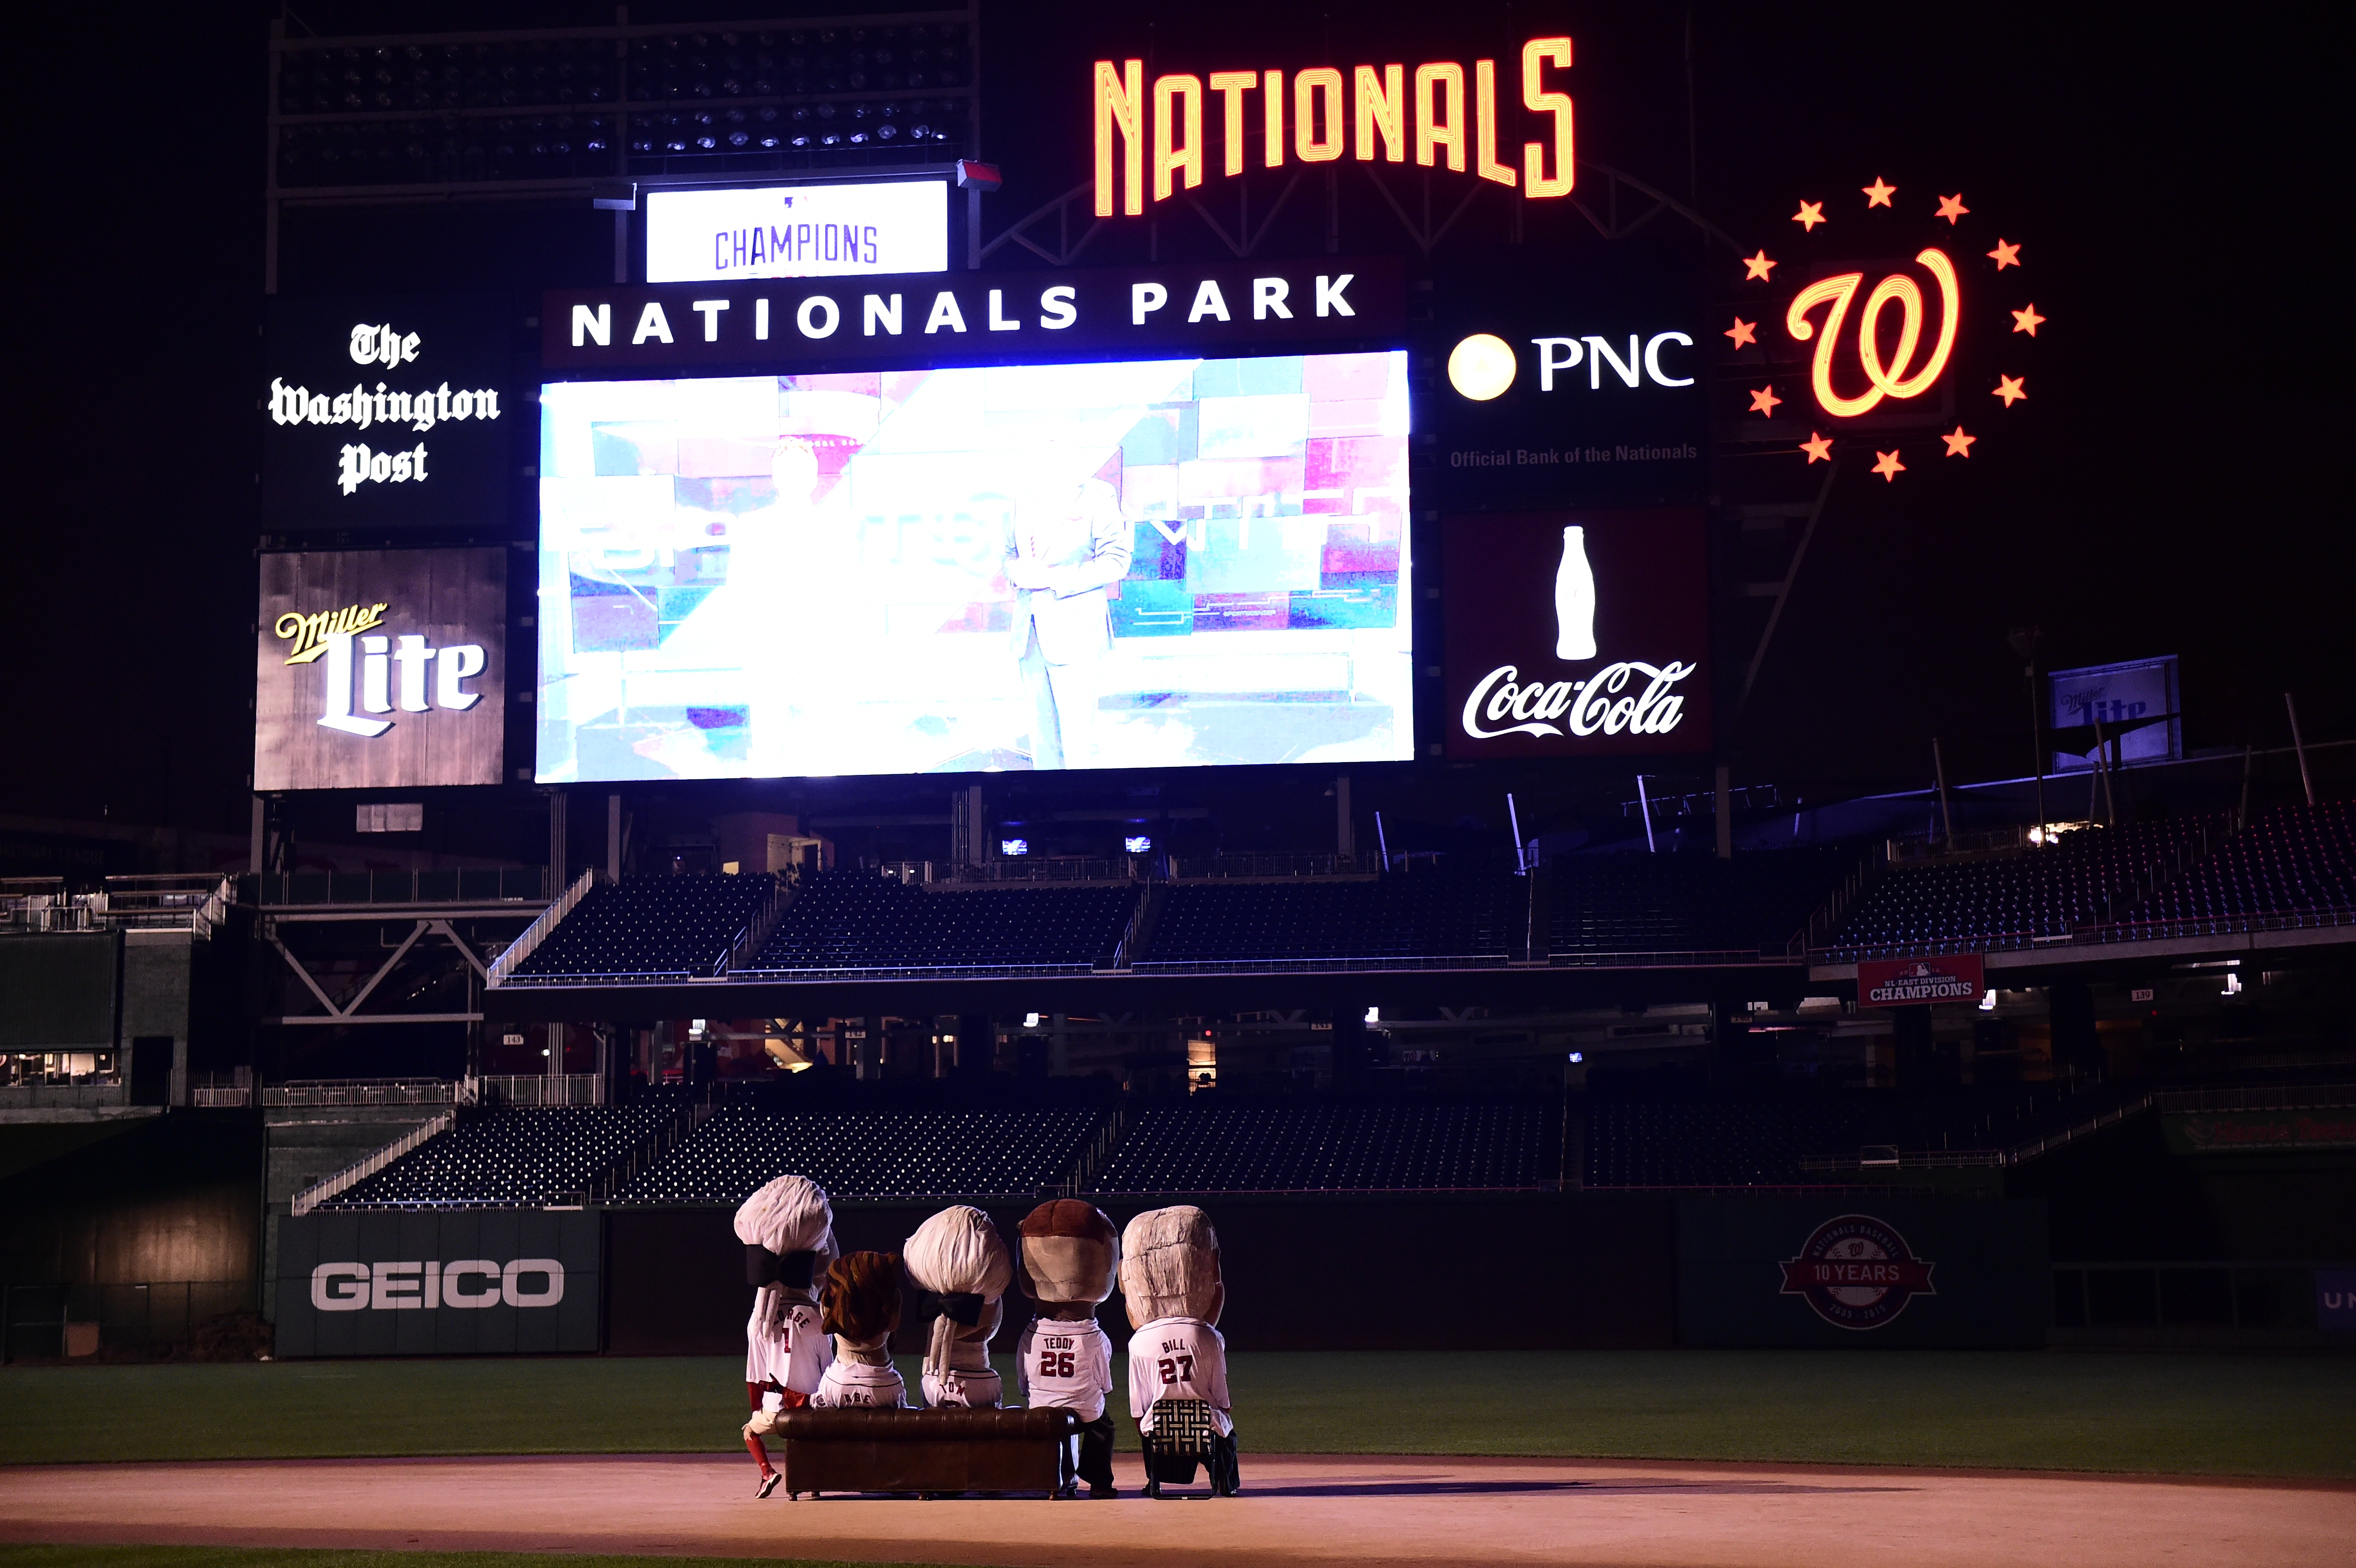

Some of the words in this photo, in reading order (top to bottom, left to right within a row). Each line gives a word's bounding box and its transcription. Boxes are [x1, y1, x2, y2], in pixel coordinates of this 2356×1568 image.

[1093, 37, 1574, 217] NATIONALS
[715, 223, 877, 271] CHAMPIONS
[572, 286, 1077, 347] NATIONALS
[1132, 273, 1355, 325] PARK
[349, 322, 421, 370] The
[1786, 248, 1959, 417] W
[1530, 331, 1694, 392] PNC
[267, 376, 501, 432] Washington
[337, 441, 428, 496] Post
[1450, 449, 1511, 468] Official
[1516, 447, 1560, 465] Bank
[1564, 446, 1581, 463] of
[1584, 446, 1611, 462] the
[1615, 443, 1698, 461] Nationals
[275, 602, 388, 665] Miller
[316, 633, 487, 737] Lite
[1462, 660, 1697, 739] Coca-Cola
[2061, 687, 2105, 716] Miller
[1869, 981, 1973, 1002] CHAMPIONS
[1920, 976, 1956, 985] DIVISION
[2136, 991, 2150, 1000] 139
[507, 1034, 521, 1044] 143
[2214, 1121, 2290, 1142] Harris
[1811, 1224, 1855, 1258] NATIONALS
[1859, 1225, 1900, 1258] BASEBALL
[310, 1258, 565, 1311] GEICO
[1814, 1264, 1830, 1281] 10
[1834, 1264, 1900, 1281] YEARS
[1829, 1303, 1853, 1319] 2005
[1043, 1337, 1075, 1350] TEDDY
[1162, 1338, 1186, 1354] BILL
[1040, 1351, 1075, 1378] 26
[1158, 1355, 1193, 1384] 27
[844, 1393, 871, 1404] ABE
[939, 1381, 965, 1396] TOM
